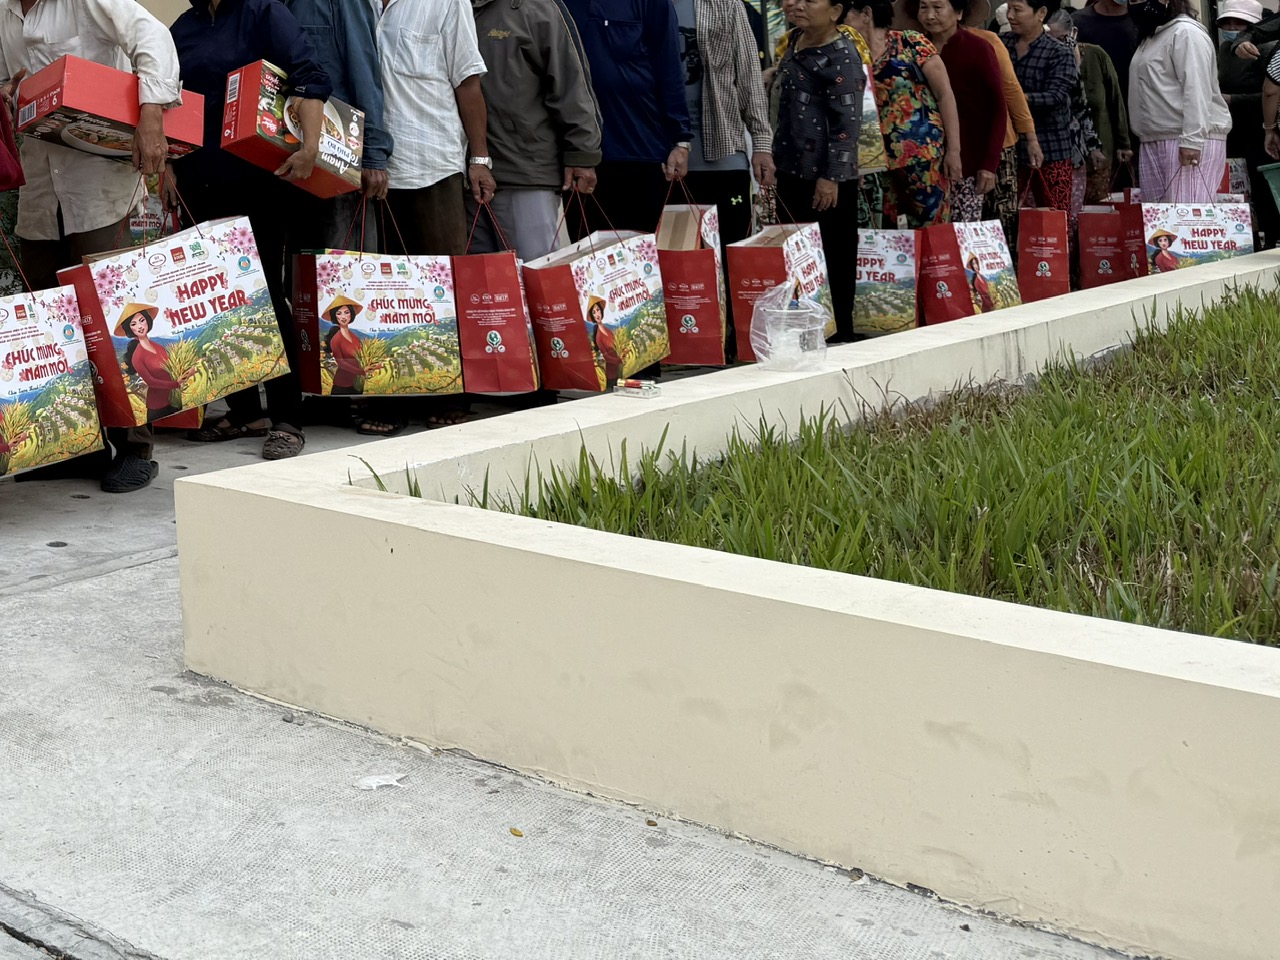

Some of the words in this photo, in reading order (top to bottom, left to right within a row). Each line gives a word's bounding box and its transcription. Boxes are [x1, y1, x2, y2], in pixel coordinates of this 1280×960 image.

[1191, 228, 1224, 237] HAPPY
[1184, 240, 1208, 250] NEW
[1210, 240, 1237, 250] YEAR
[856, 258, 884, 268] APPY
[866, 271, 895, 283] YEAR
[177, 272, 225, 300] HAPPY
[169, 302, 207, 327] NEW
[208, 289, 247, 315] YEAR
